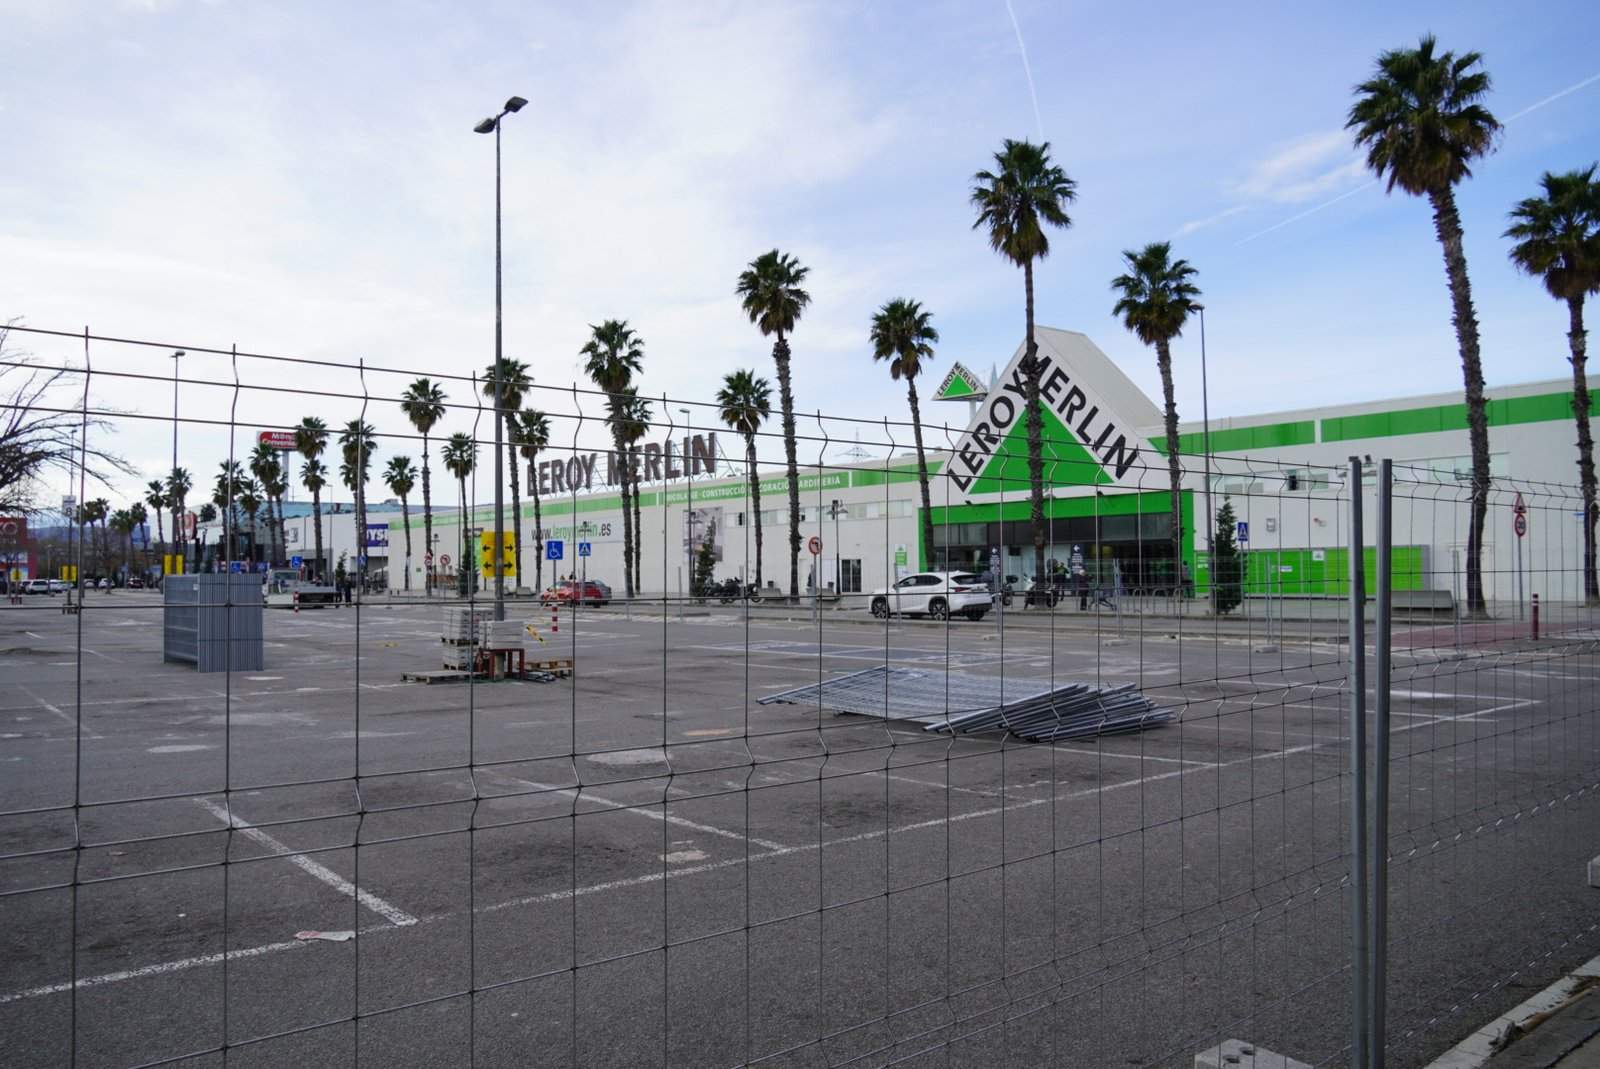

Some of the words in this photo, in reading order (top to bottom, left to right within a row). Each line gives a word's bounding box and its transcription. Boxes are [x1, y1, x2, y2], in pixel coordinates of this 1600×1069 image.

[937, 369, 956, 396] LEROY
[953, 360, 979, 392] MERLIN
[947, 369, 1030, 492] LEROY
[527, 453, 597, 497] LEROY
